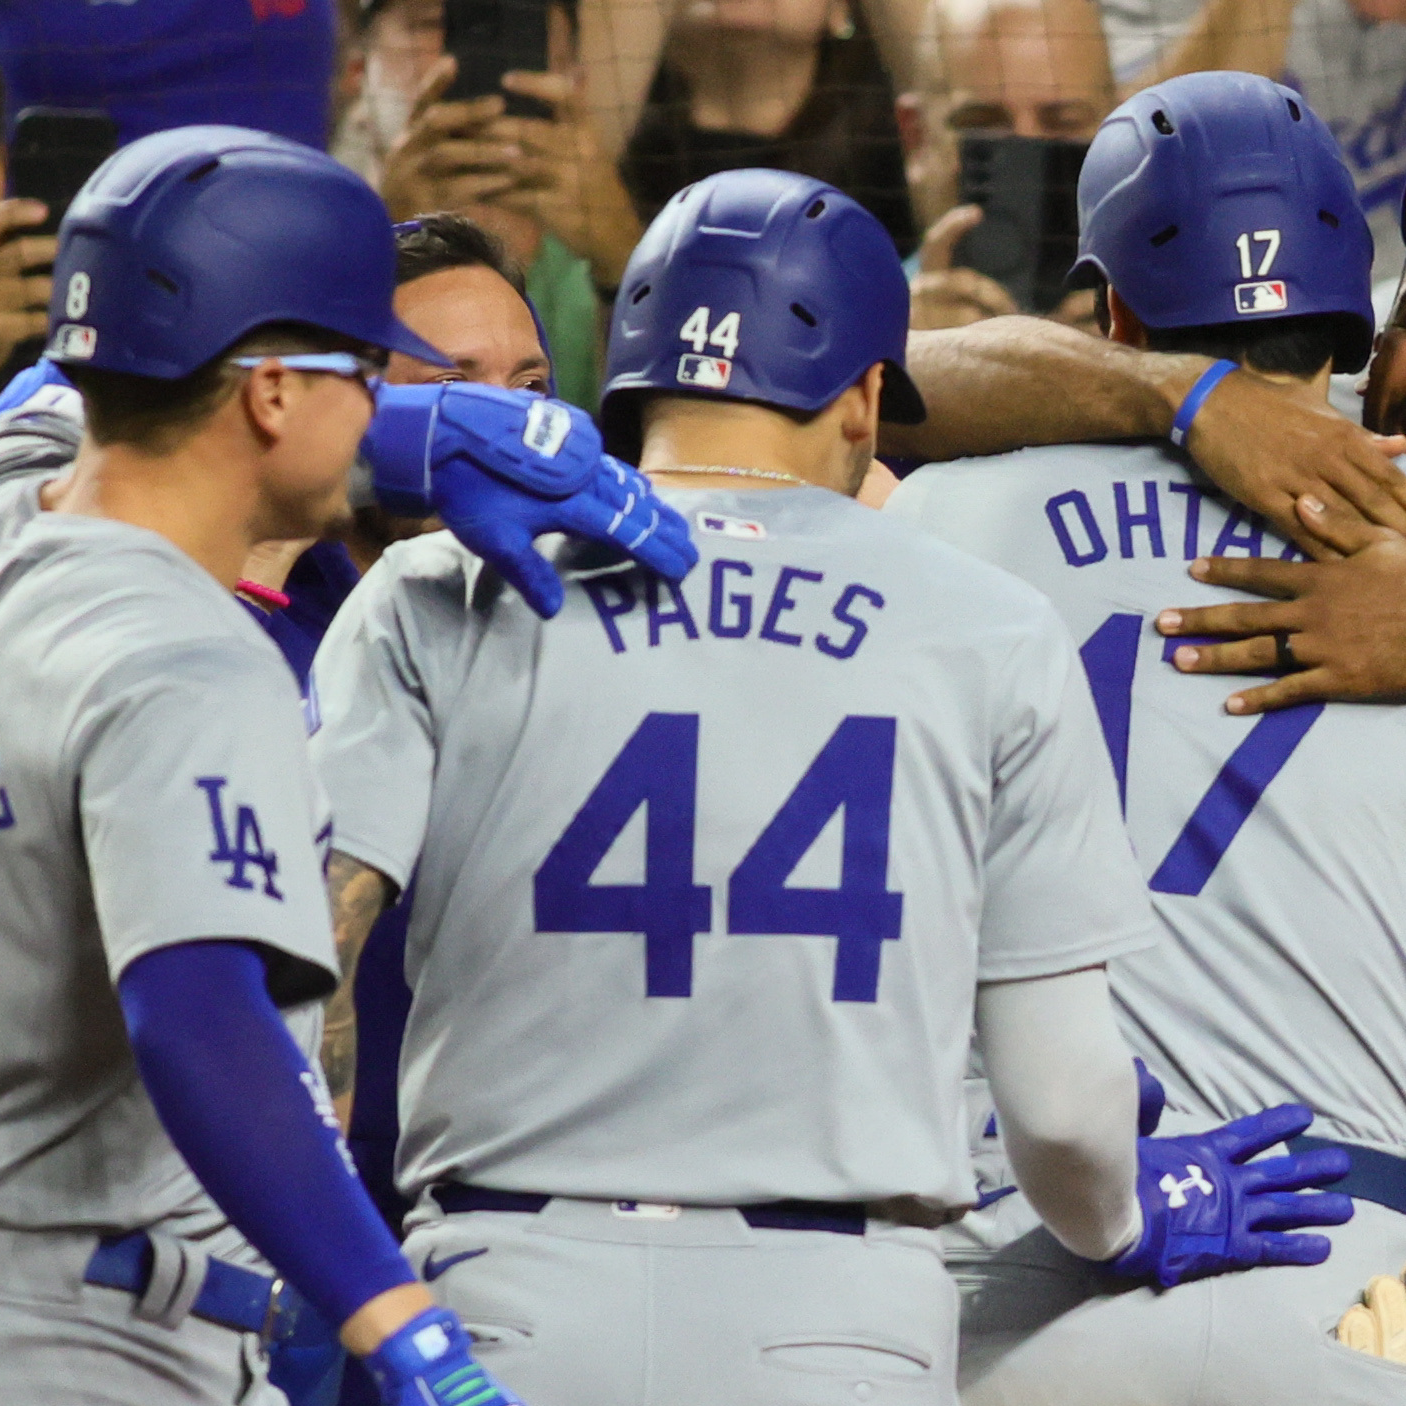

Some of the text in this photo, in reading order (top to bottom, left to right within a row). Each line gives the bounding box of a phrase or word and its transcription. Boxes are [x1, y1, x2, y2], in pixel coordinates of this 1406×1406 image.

[65, 270, 91, 320] 8
[1235, 229, 1281, 278] 17
[679, 305, 741, 359] 44
[1045, 480, 1318, 567] OHTA
[579, 557, 885, 661] PAGES
[194, 776, 284, 902] LA
[533, 711, 904, 1004] 44
